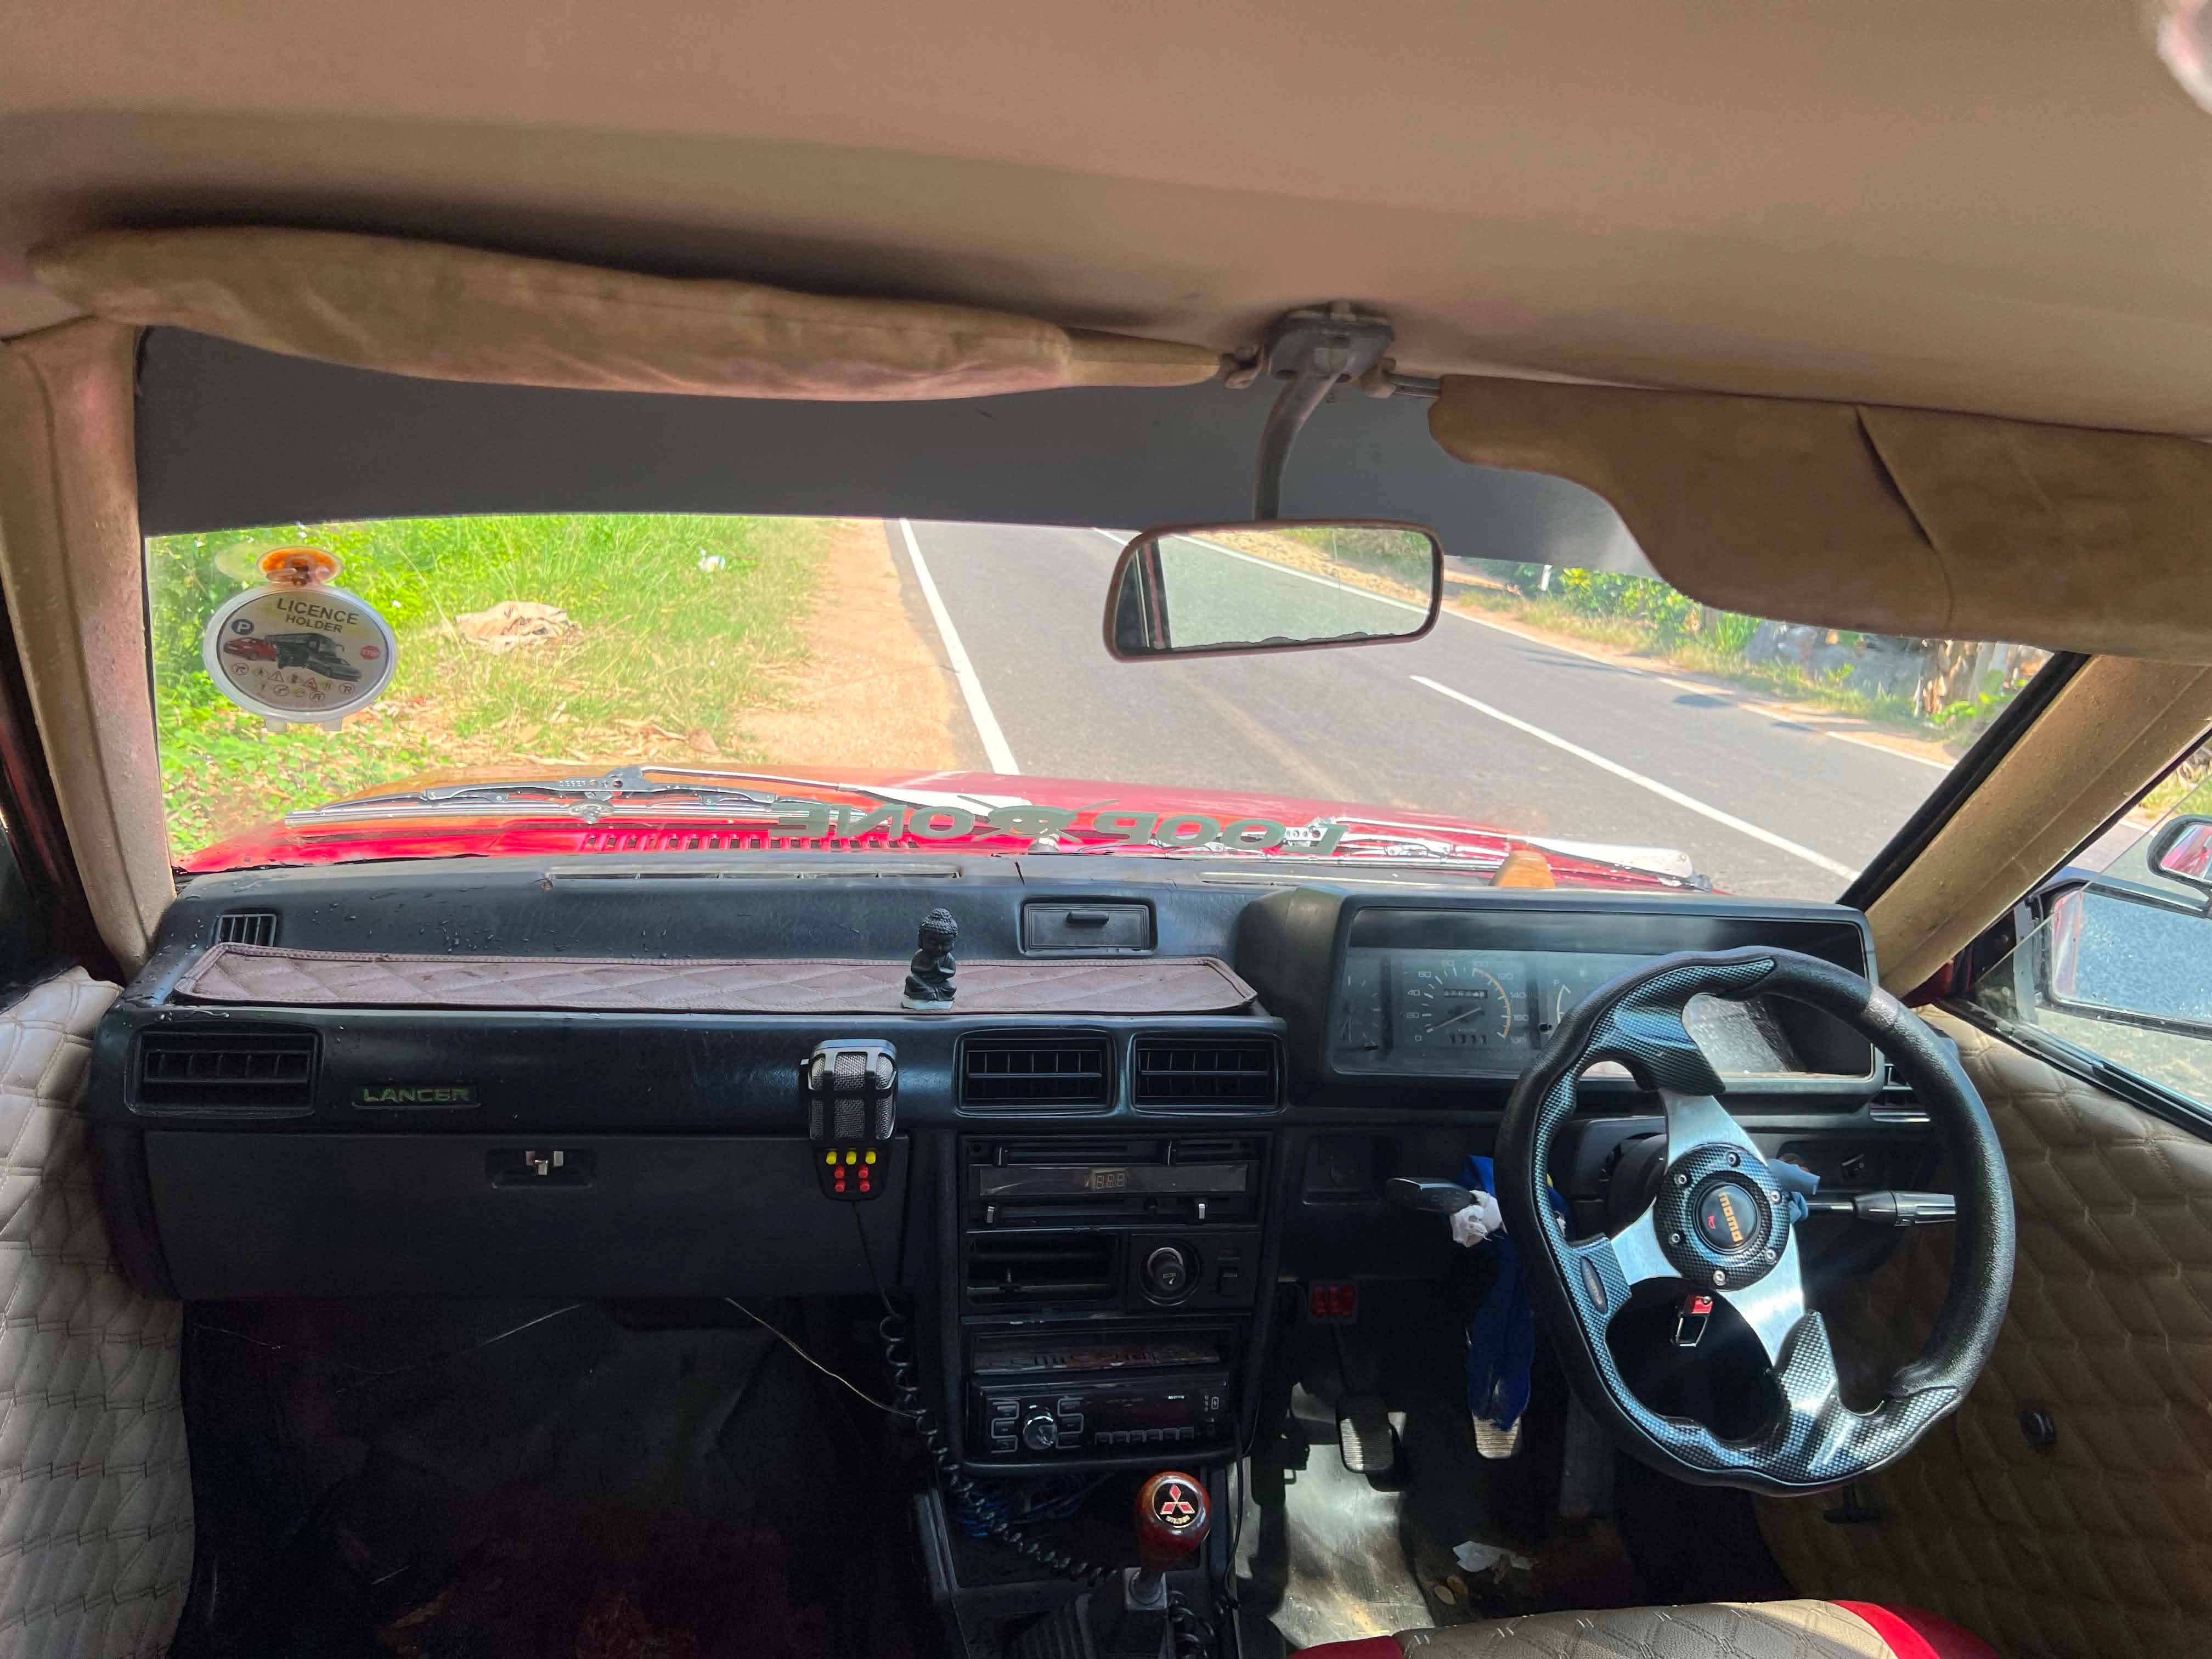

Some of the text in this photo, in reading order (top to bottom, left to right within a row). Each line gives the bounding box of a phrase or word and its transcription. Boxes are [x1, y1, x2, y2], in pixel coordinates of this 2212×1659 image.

[276, 597, 359, 625] LICENCE
[285, 614, 343, 634] HOLDER
[364, 1088, 470, 1102] LANCER
